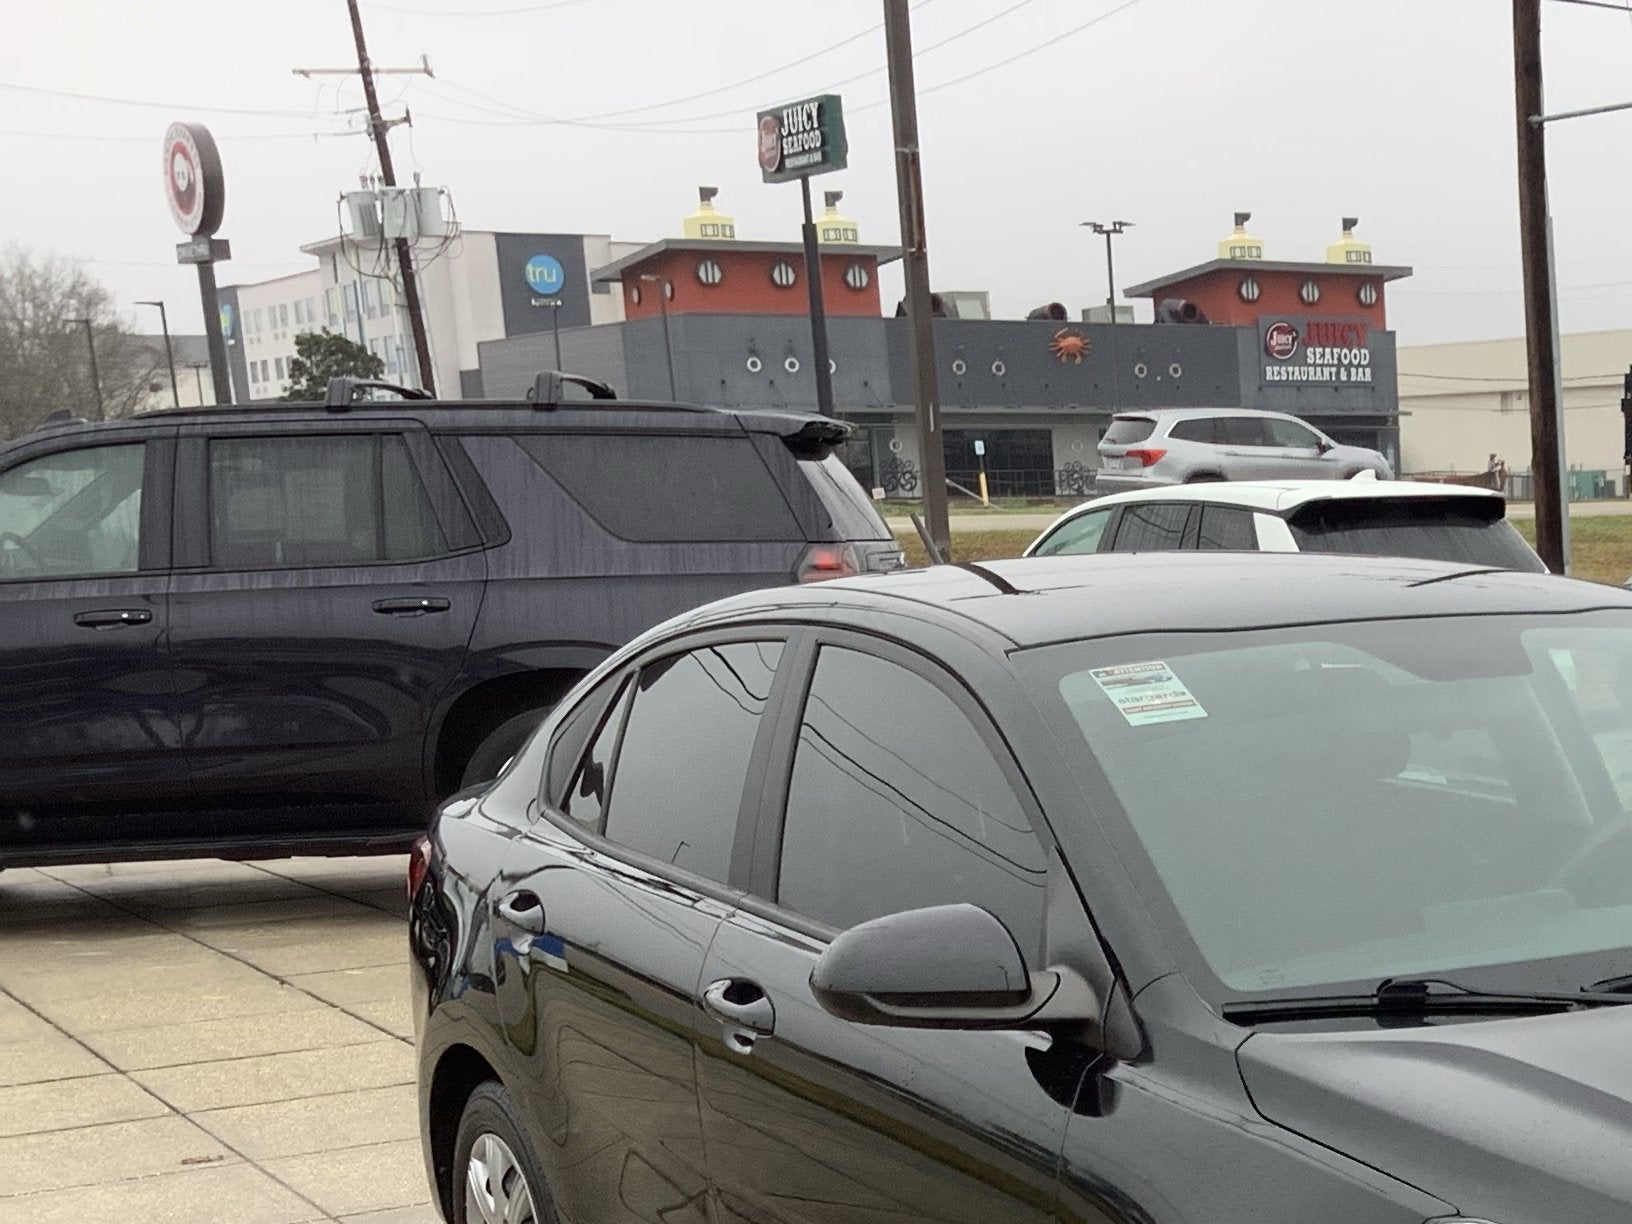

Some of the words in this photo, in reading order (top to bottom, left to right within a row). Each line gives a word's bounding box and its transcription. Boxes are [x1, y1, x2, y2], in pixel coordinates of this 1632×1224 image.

[781, 101, 819, 136] JUICY
[782, 129, 822, 156] SEAFOOD
[528, 263, 557, 283] tru
[1302, 322, 1368, 347] JUICY
[1306, 347, 1370, 366] SEAFOOD
[1265, 366, 1337, 381] RESTAURANT
[1340, 367, 1348, 381] &
[1350, 367, 1372, 382] BAR
